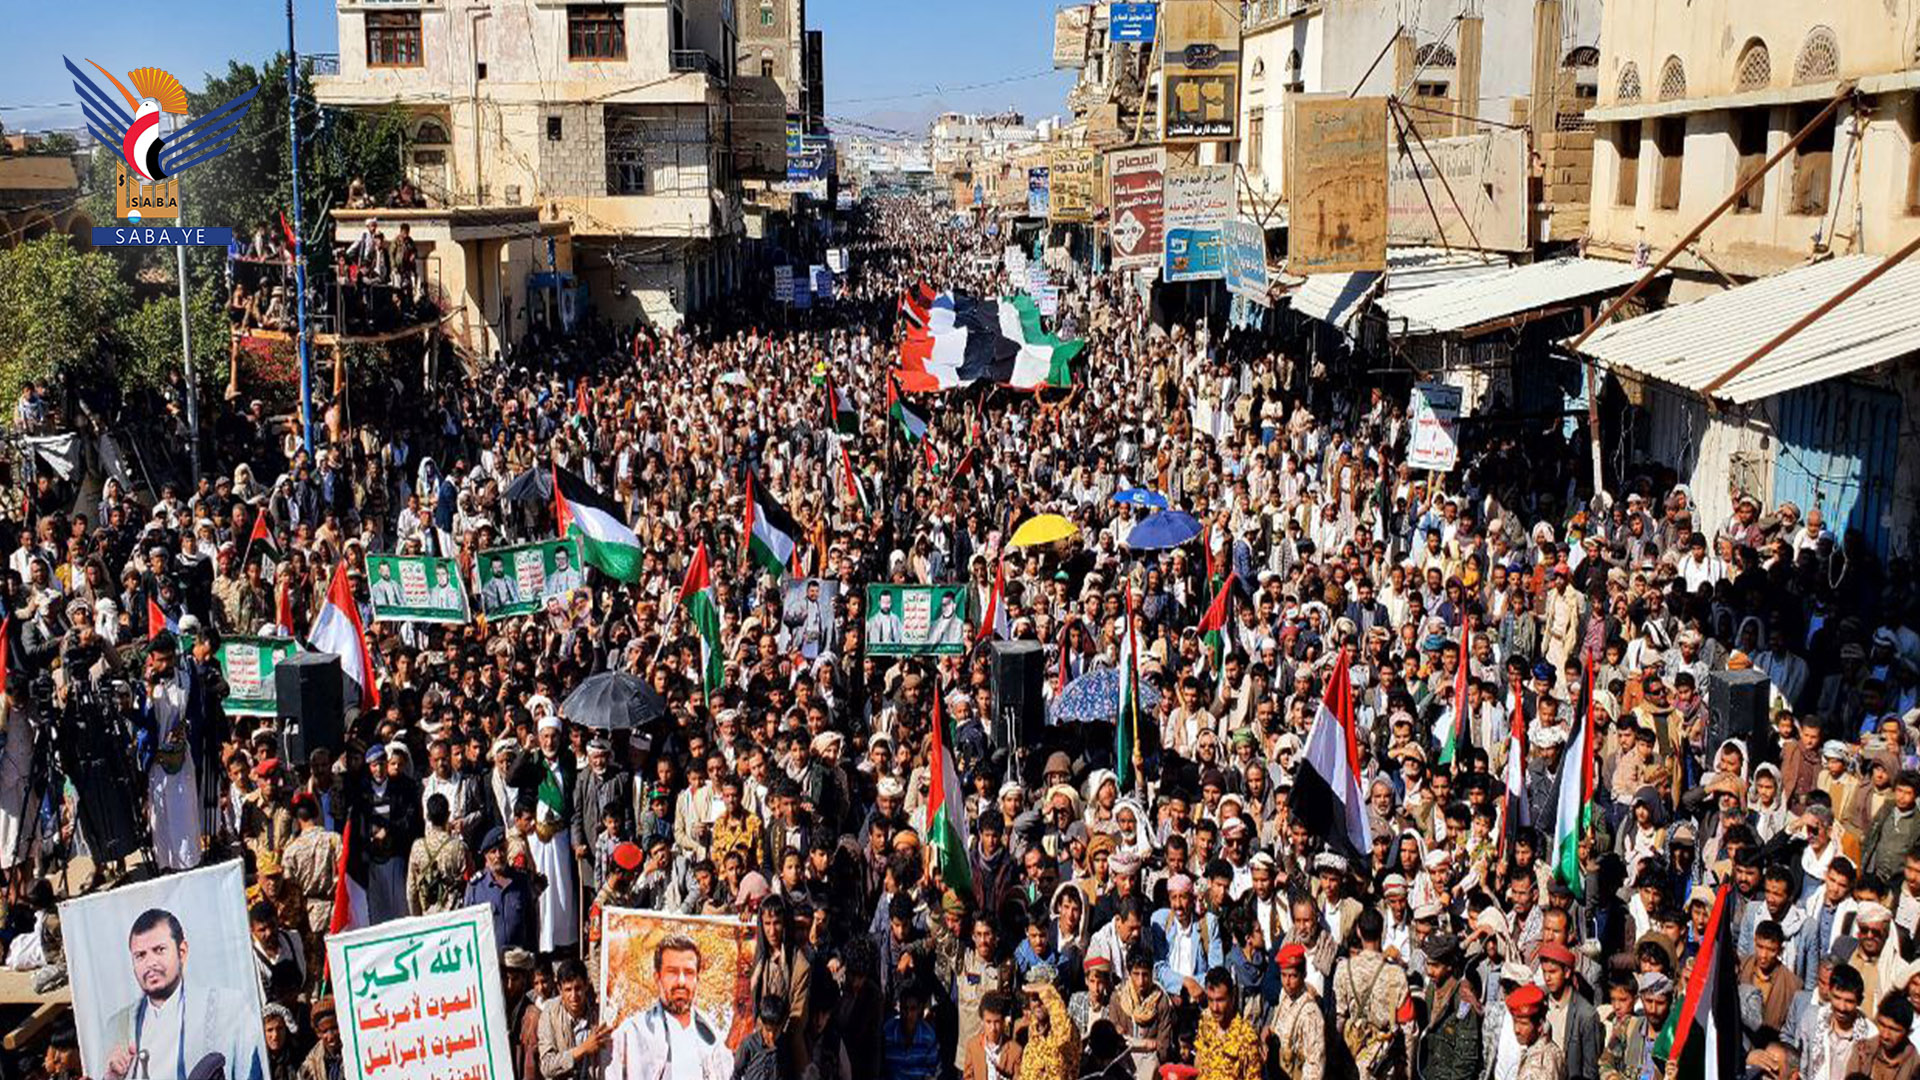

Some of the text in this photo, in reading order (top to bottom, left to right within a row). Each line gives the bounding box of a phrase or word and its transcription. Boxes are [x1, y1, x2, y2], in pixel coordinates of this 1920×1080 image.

[354, 936, 474, 1000] الله أكبر
[426, 984, 478, 1021] الموت
[364, 1023, 483, 1076] الموت لإسرائيل
